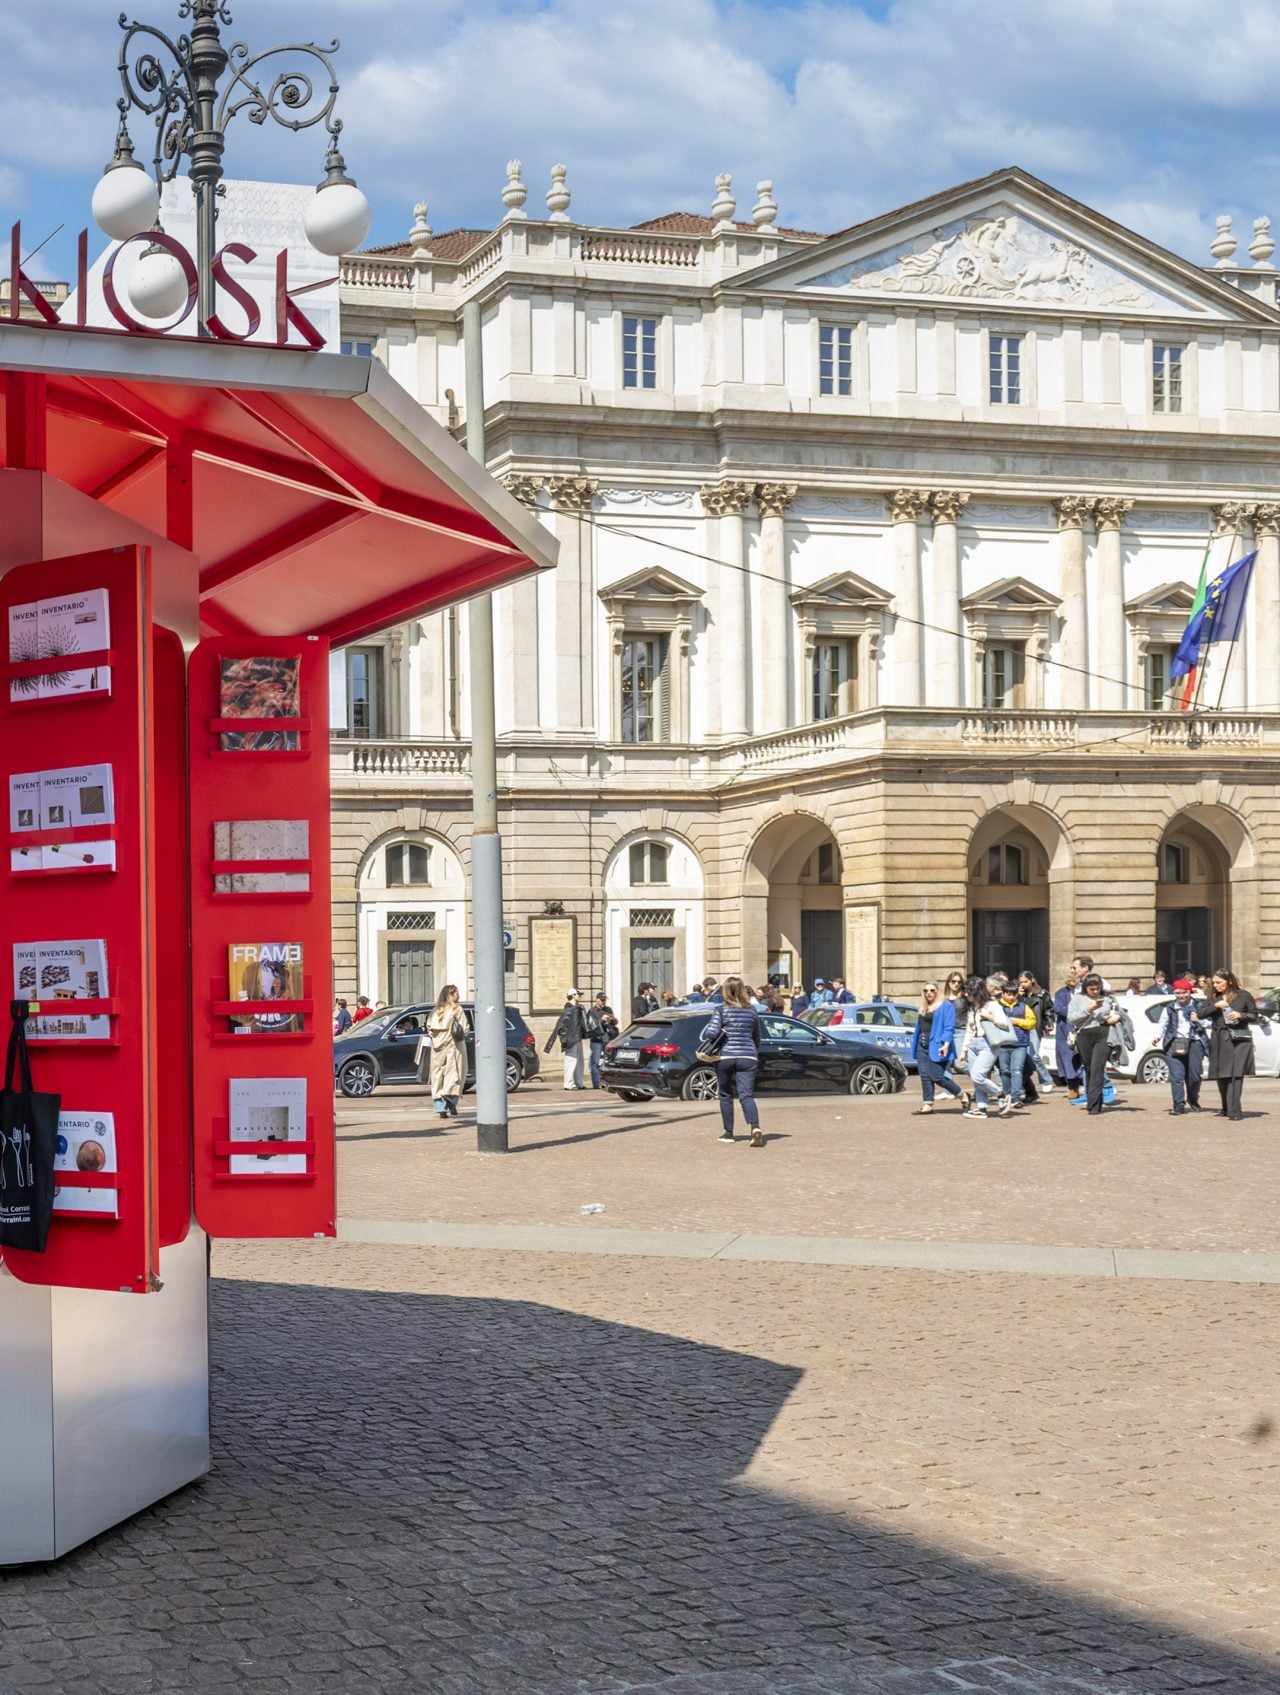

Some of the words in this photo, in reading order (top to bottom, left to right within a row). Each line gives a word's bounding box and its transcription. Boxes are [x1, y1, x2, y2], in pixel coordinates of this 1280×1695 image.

[10, 221, 341, 350] KIOSK
[41, 601, 85, 615] INVENTARIO
[13, 611, 38, 621] INVENT
[14, 781, 40, 790] INVENT
[44, 775, 88, 786] INVENTARIO
[39, 949, 81, 958] INVENTARIO
[876, 1035, 911, 1048] POLI
[60, 1120, 90, 1128] ENTARIO
